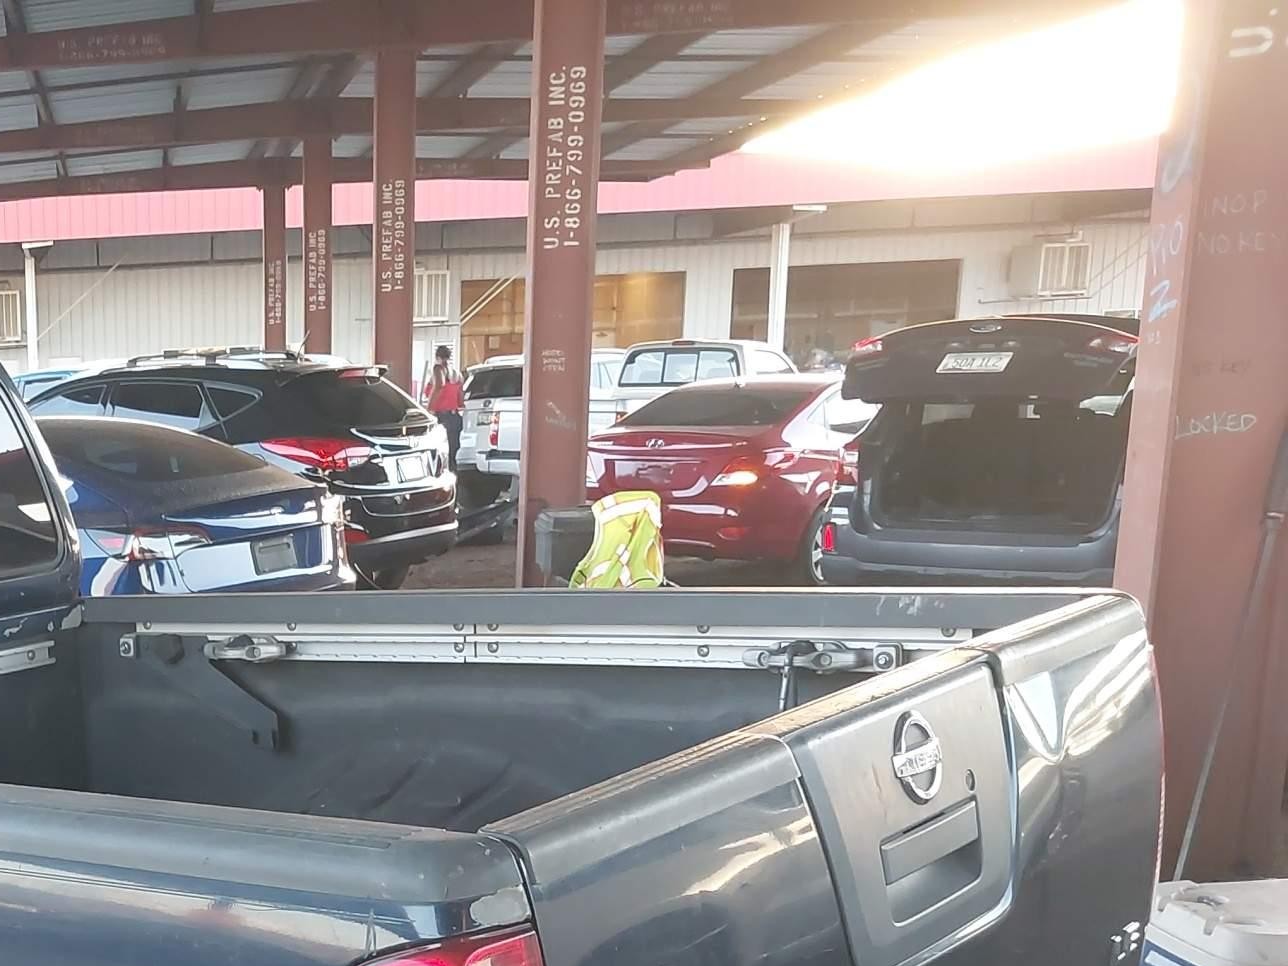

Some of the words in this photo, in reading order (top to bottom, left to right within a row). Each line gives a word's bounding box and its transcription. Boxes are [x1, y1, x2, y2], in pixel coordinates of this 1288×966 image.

[548, 66, 567, 106] INC.
[545, 117, 564, 199] PREFAB
[563, 65, 587, 247] 1-866-799-0969
[381, 210, 393, 261] PREFAB
[394, 179, 405, 290] 1-866-799-0969
[543, 210, 561, 250] U.S.
[309, 251, 317, 289] PREFAB
[1174, 411, 1257, 440] LOCKED
